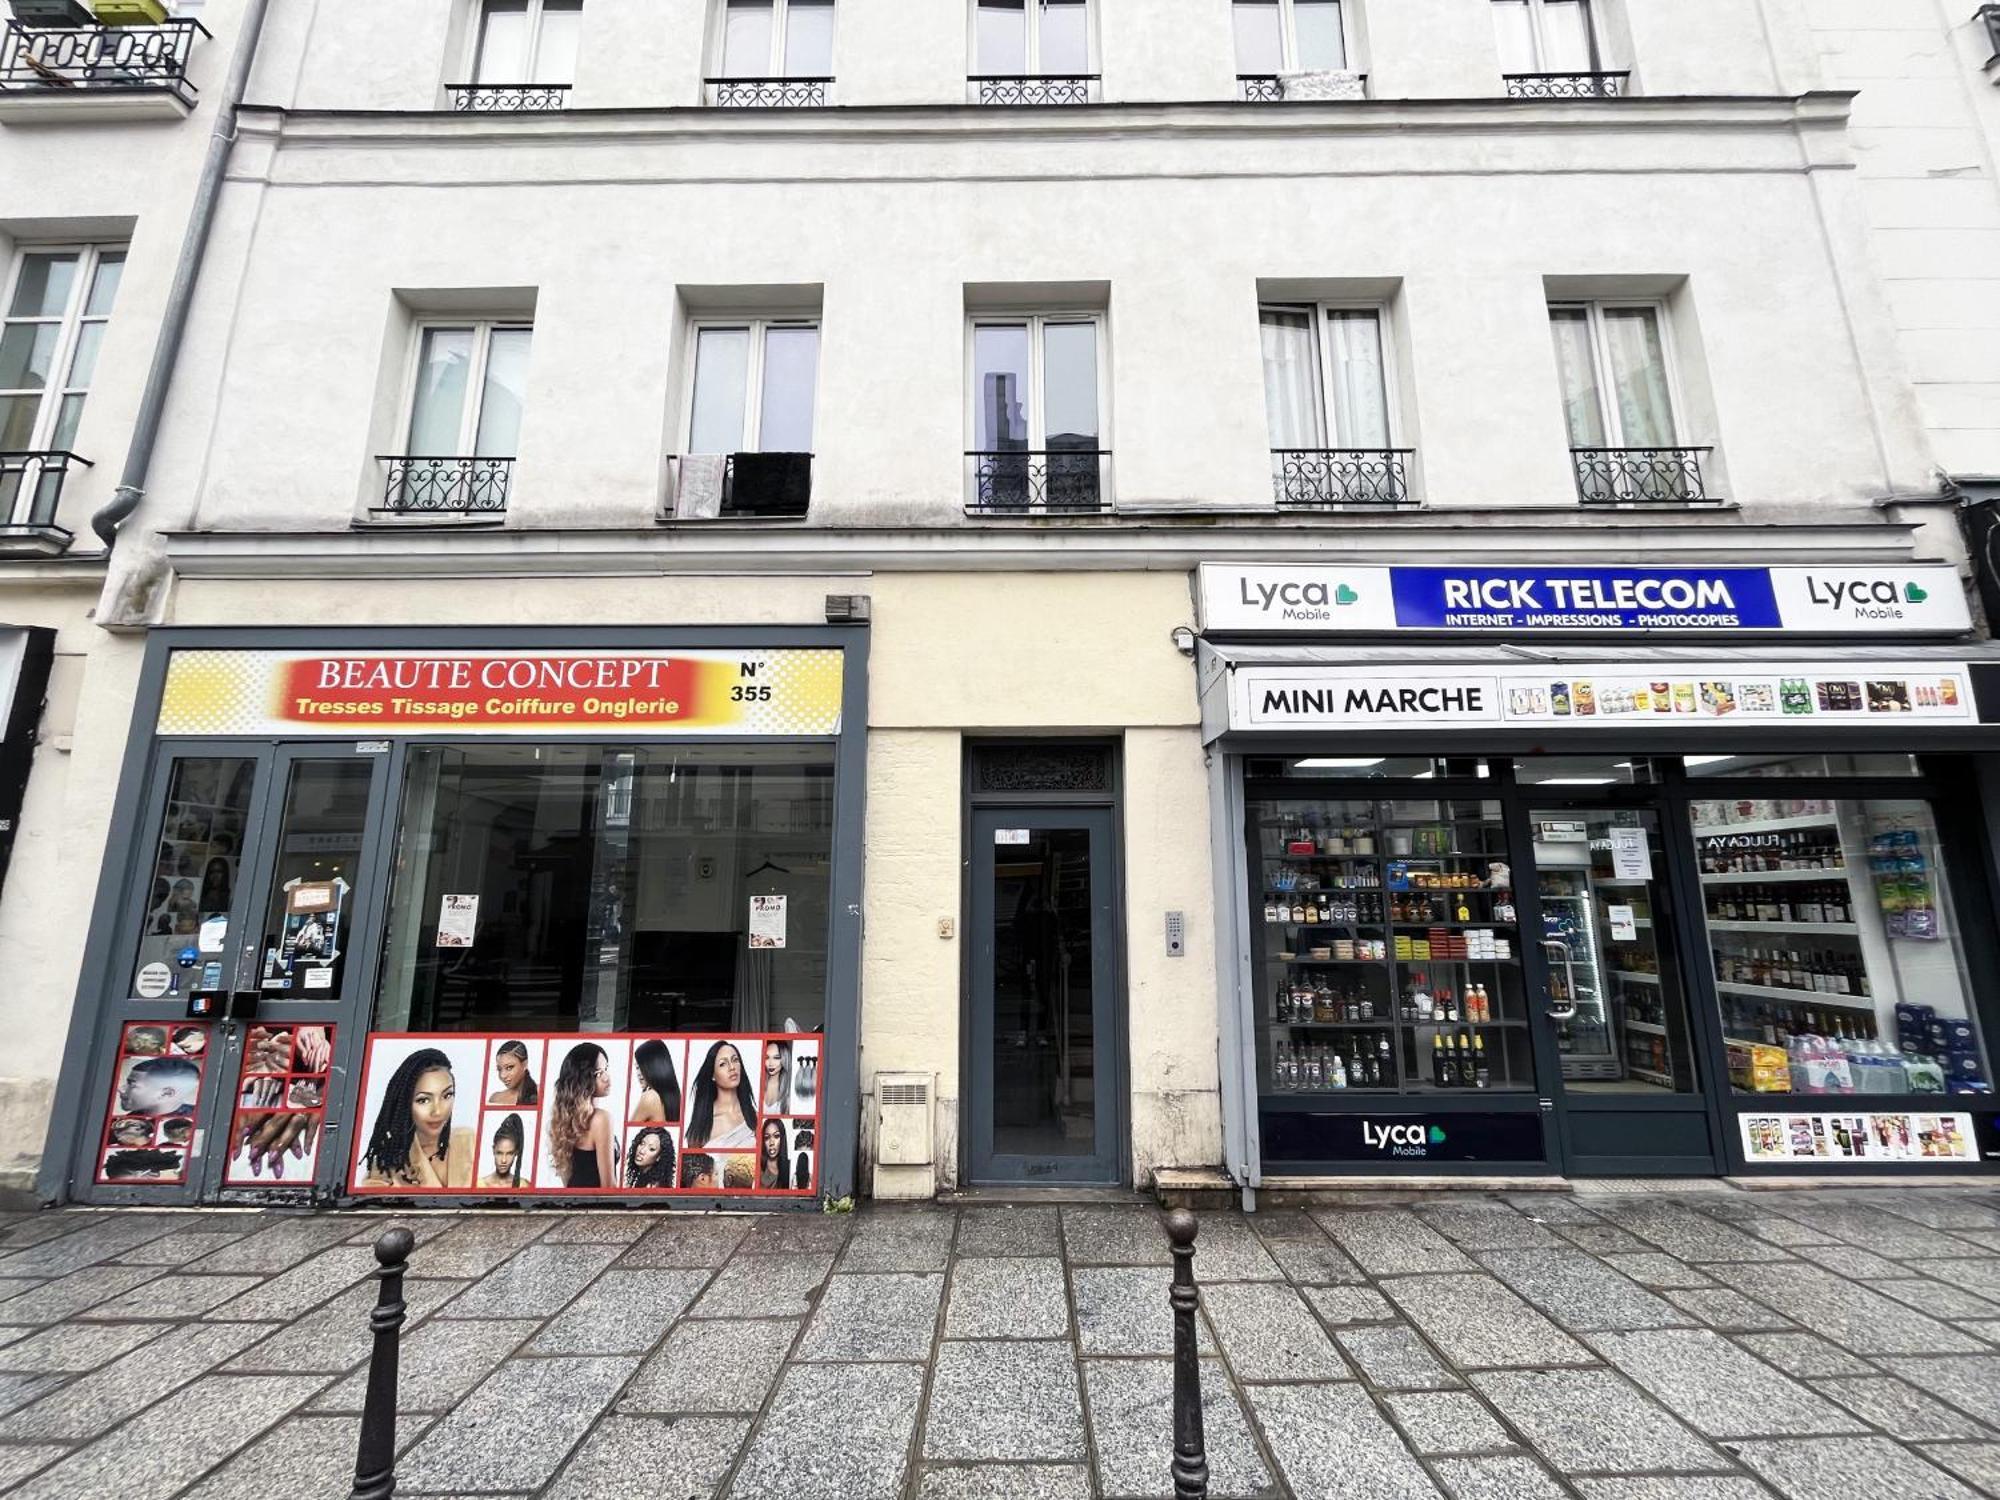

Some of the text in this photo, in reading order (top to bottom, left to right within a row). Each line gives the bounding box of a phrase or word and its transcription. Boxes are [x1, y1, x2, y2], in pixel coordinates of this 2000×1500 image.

[1240, 577, 1329, 611] Lyca
[1444, 578, 1736, 609] RICK TELECOM
[1806, 576, 1899, 610] Lyca
[1282, 608, 1331, 620] Mobile
[1445, 614, 1514, 626] INTERNET
[1526, 614, 1622, 626] IMPRESSIONS
[1638, 614, 1740, 626] PHOTOCOPIES
[1855, 607, 1904, 619] Mobile
[316, 659, 669, 689] BEAUTE CONCEPT
[740, 662, 765, 677] N°
[730, 686, 772, 702] 355
[1262, 688, 1484, 714] MINI MARCHE
[296, 697, 680, 719] Tresses Tissage Coiffure Onglerie
[1363, 1121, 1426, 1149] Lyca
[1392, 1146, 1427, 1156] Mobile
